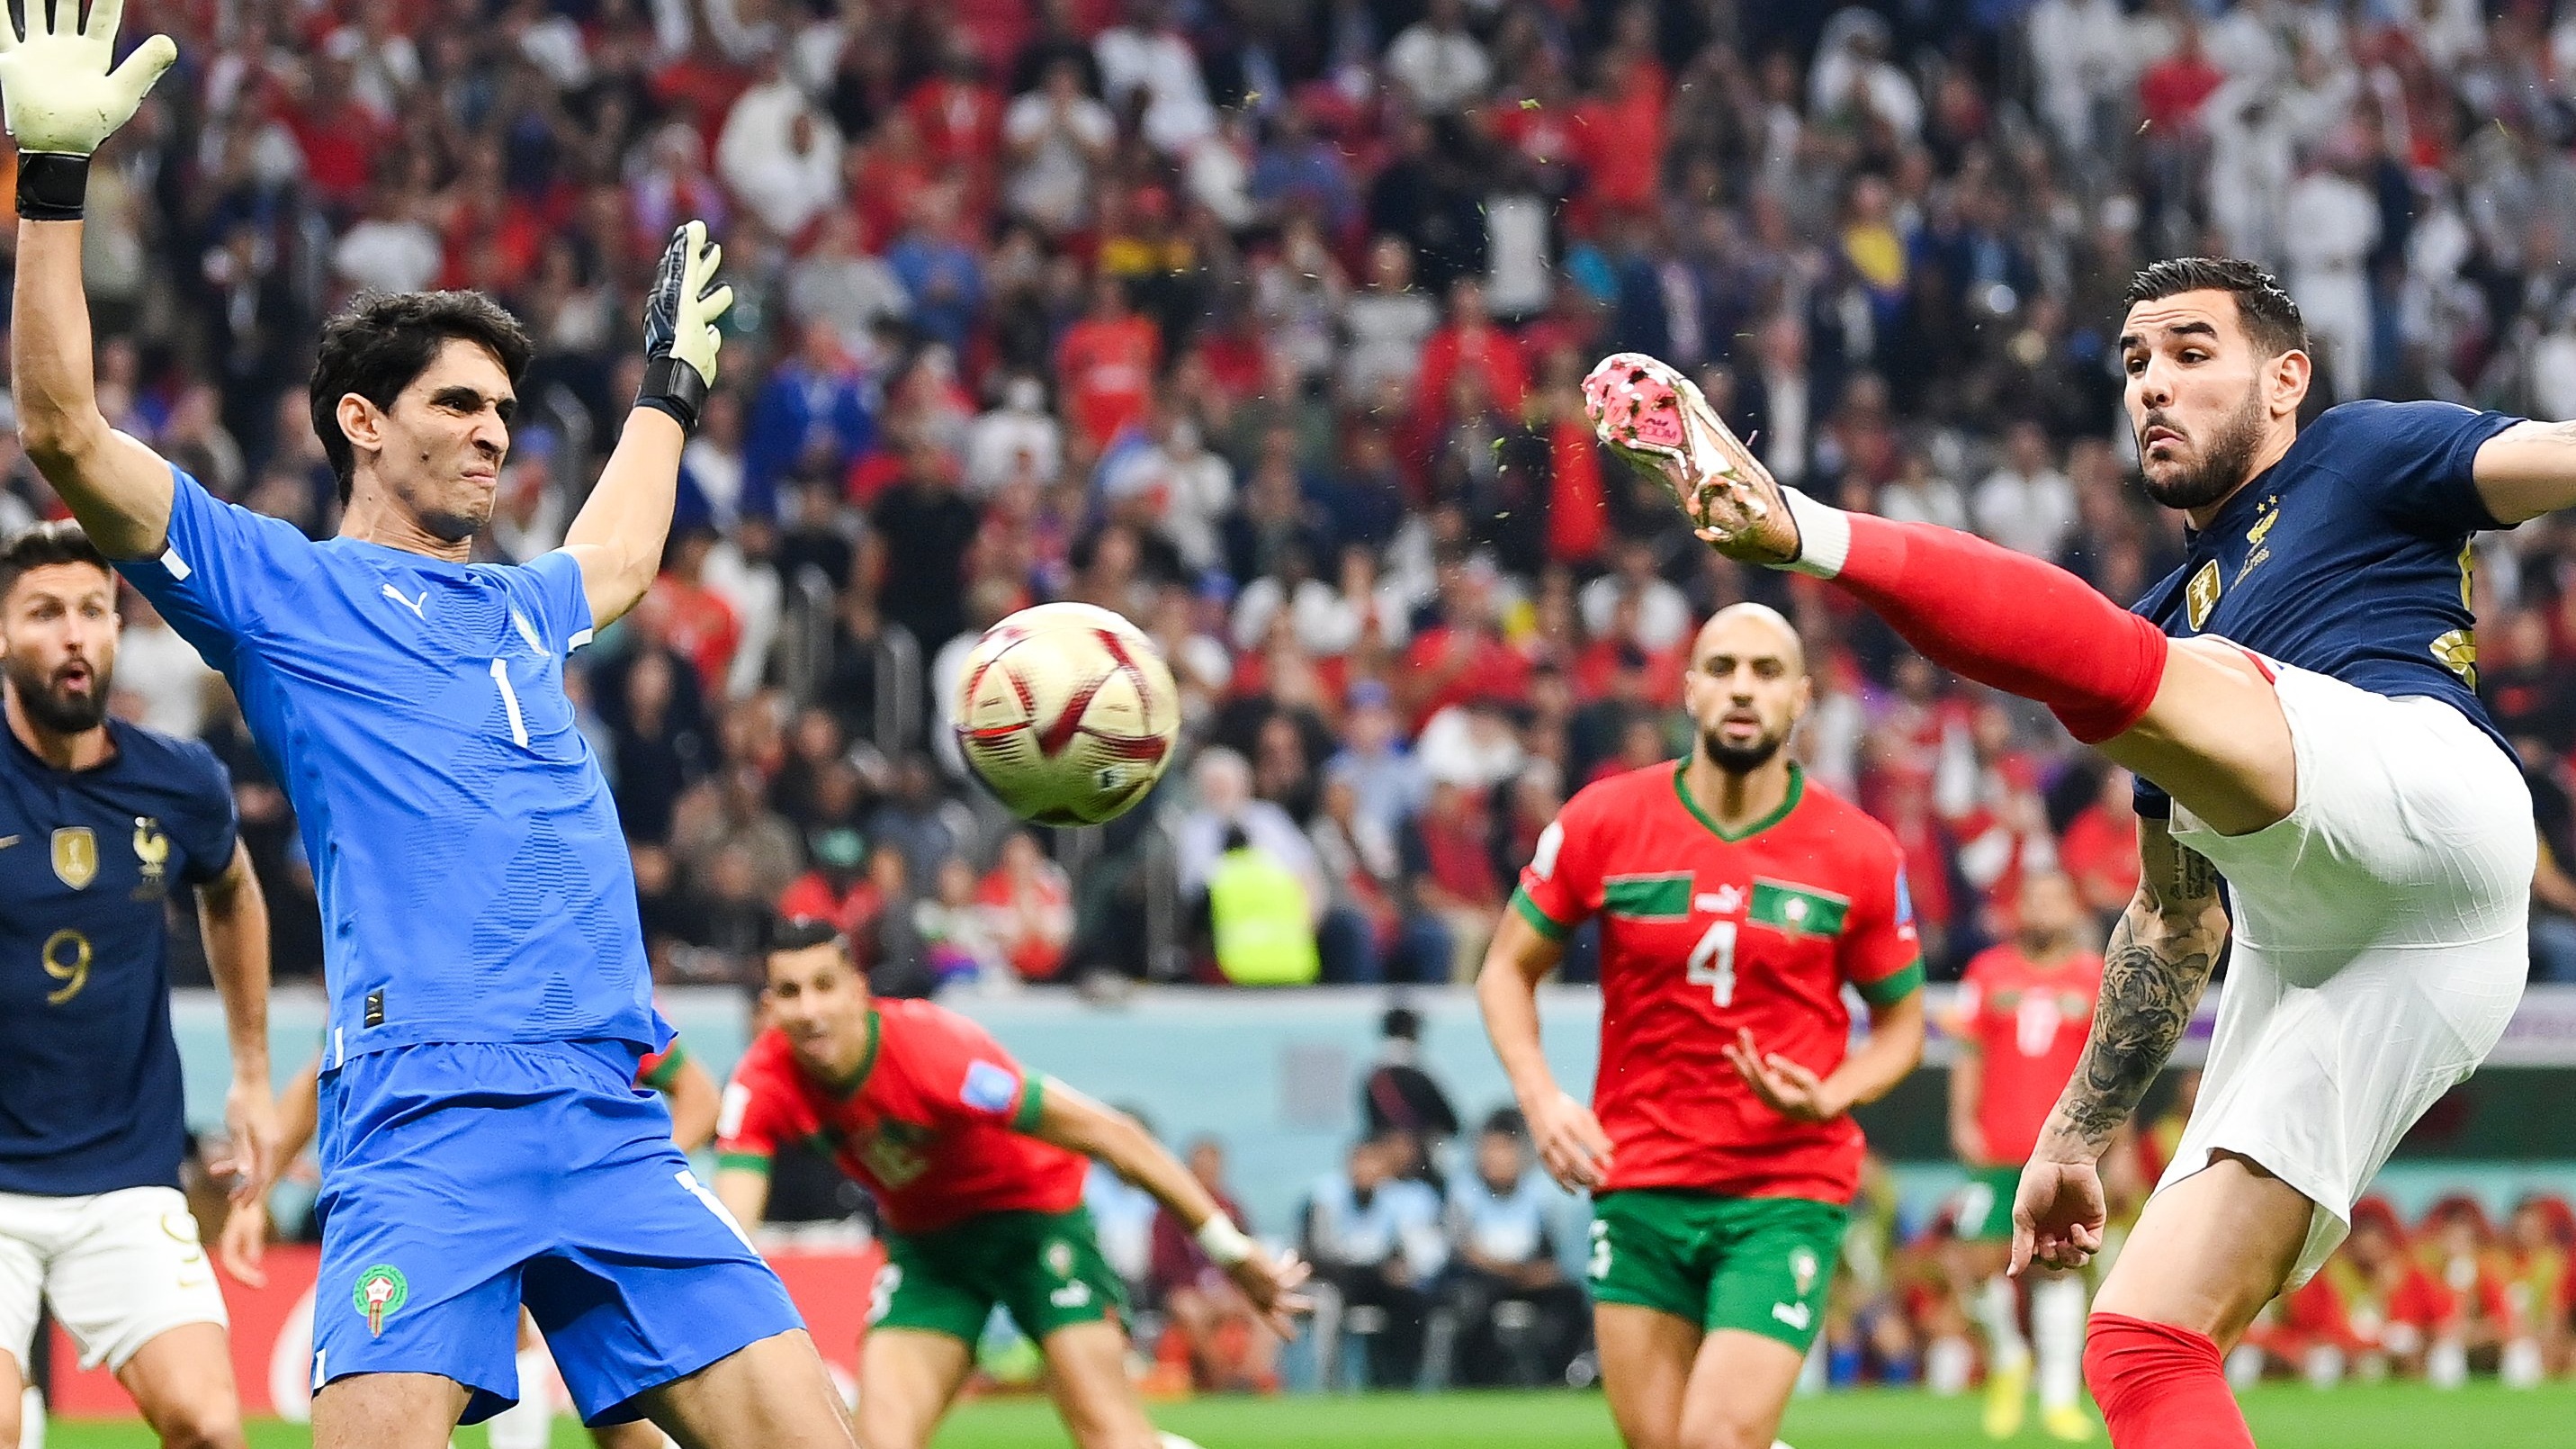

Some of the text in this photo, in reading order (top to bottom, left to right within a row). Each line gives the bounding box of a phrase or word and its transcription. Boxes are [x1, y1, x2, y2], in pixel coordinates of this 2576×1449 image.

[489, 657, 528, 749] 1
[42, 929, 92, 1004] 9
[1686, 920, 1737, 1008] 4
